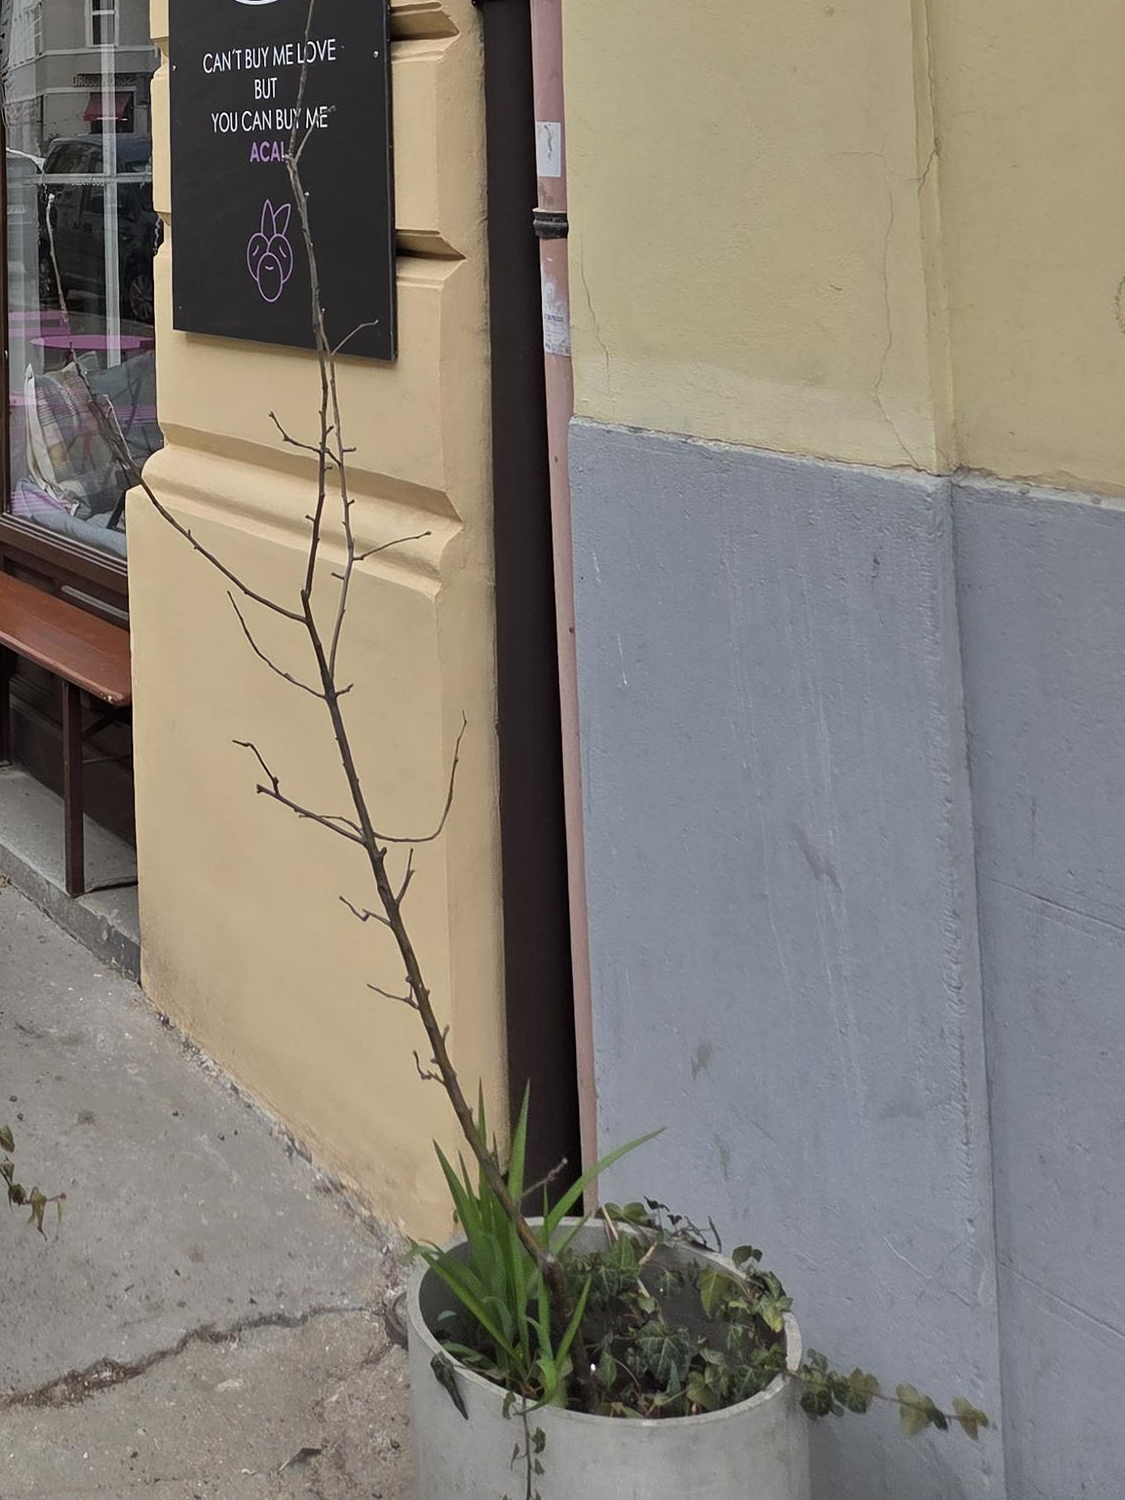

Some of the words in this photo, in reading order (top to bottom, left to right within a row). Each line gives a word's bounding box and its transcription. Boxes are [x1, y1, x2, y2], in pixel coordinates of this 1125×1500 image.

[245, 46, 269, 69] BUY
[273, 43, 293, 66] ME
[297, 38, 336, 64] LOVE
[254, 77, 277, 99] BUT
[211, 111, 238, 133] YOU
[241, 109, 272, 131] CAN
[276, 107, 302, 130] BUY
[306, 105, 328, 129] ME
